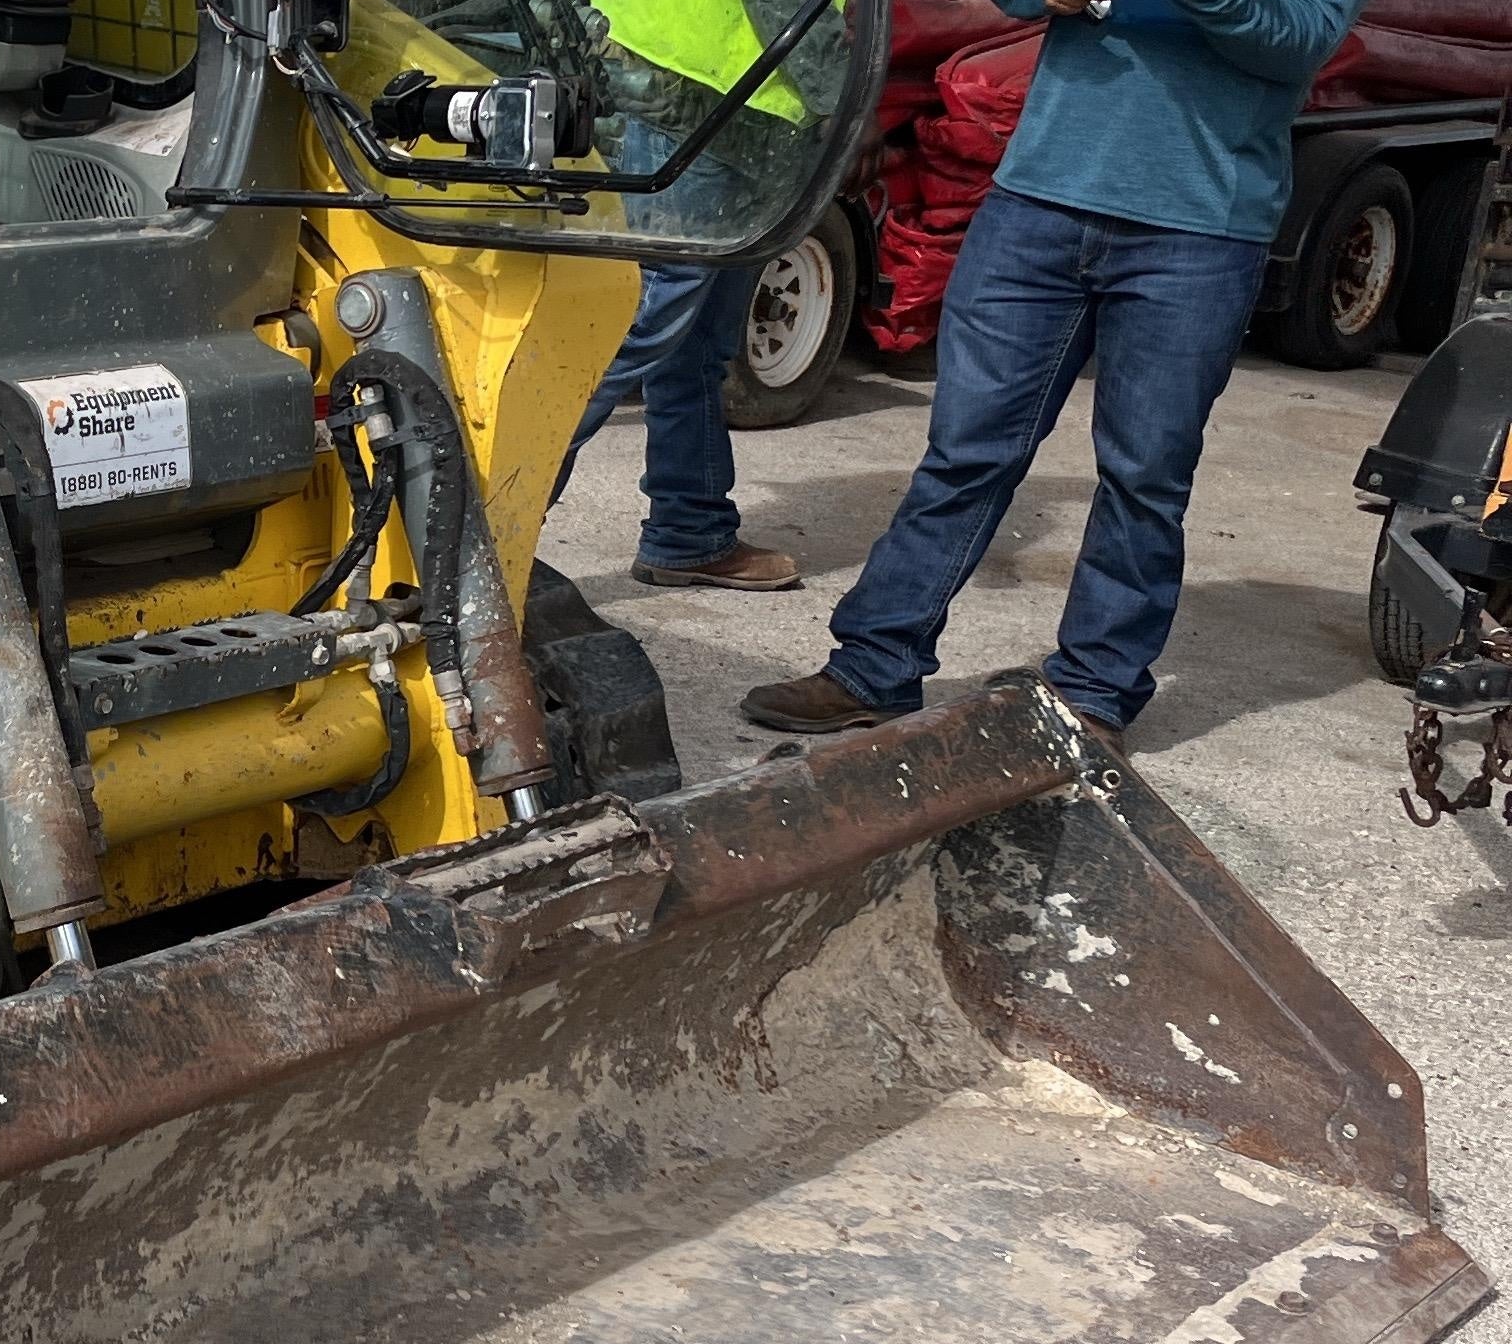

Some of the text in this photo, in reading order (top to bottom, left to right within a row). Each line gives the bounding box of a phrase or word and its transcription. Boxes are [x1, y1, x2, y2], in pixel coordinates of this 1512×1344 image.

[71, 382, 180, 414] Equipment
[79, 414, 135, 437] Share
[108, 462, 177, 485] 80-RENTS
